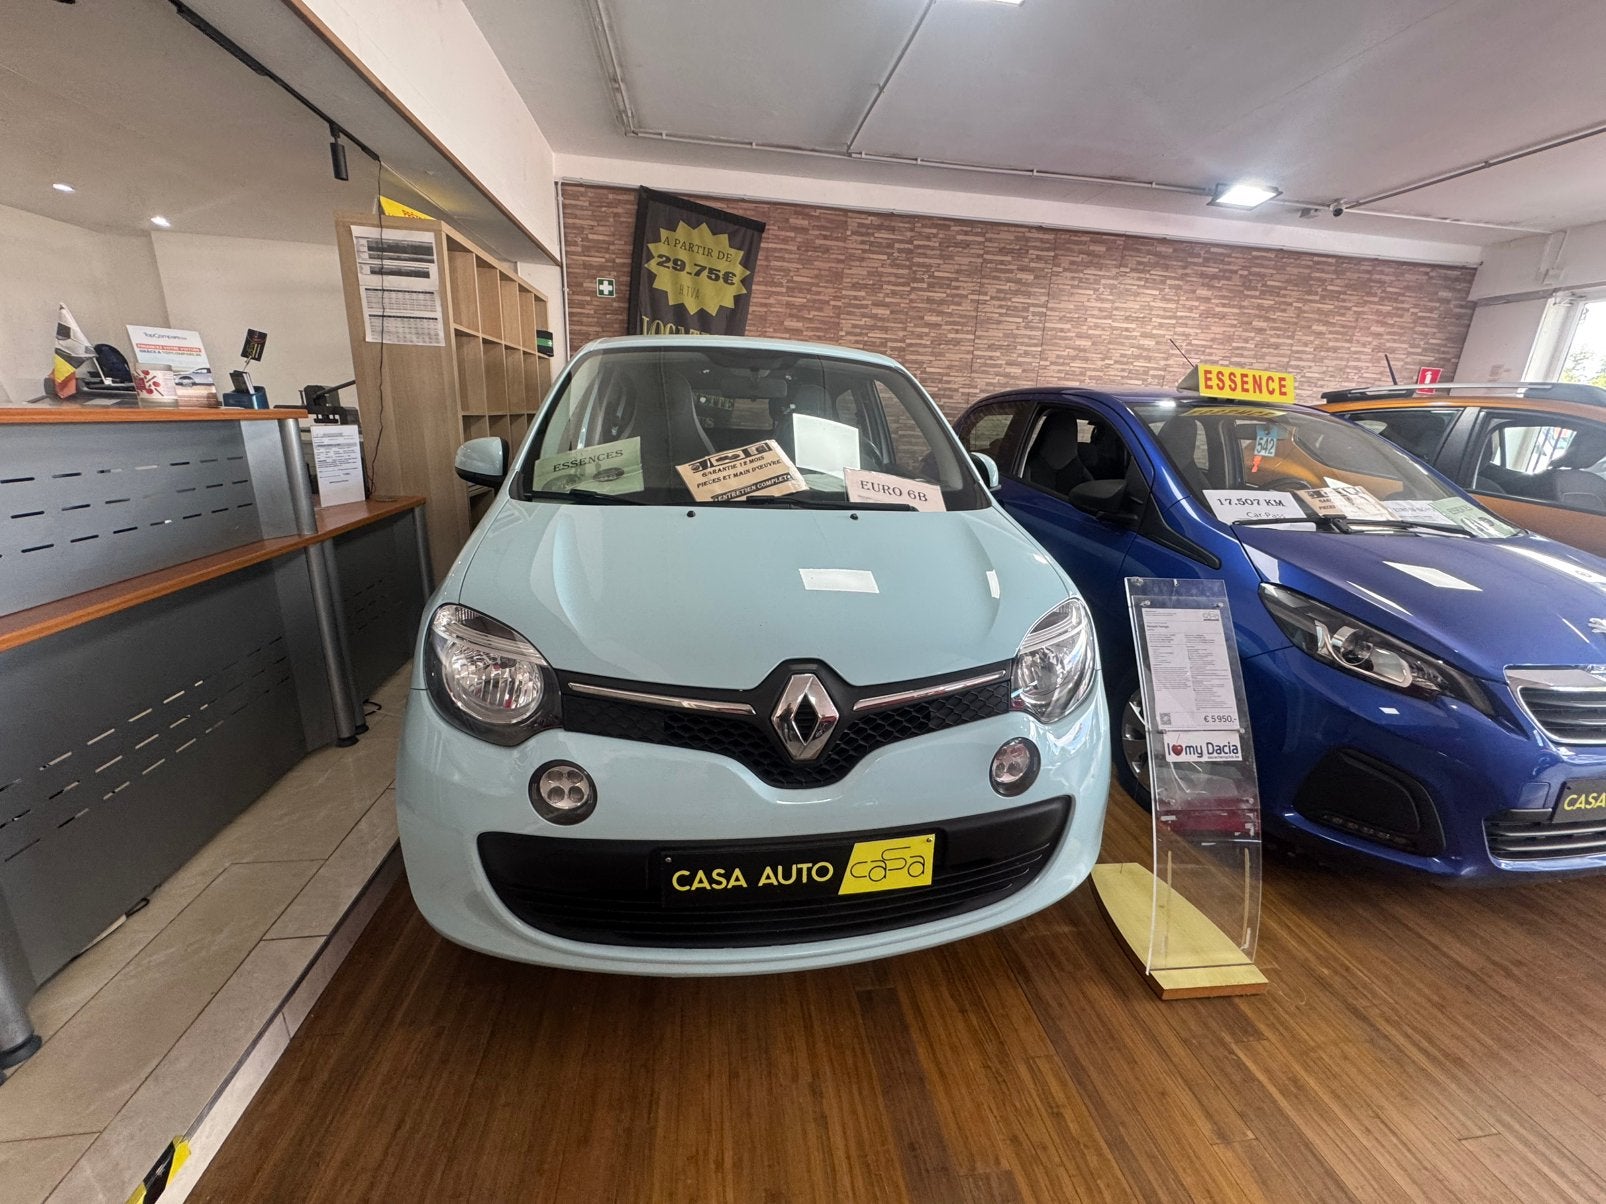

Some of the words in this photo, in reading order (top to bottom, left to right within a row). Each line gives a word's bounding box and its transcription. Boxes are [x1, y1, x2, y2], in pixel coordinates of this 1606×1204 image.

[663, 236, 671, 246] A
[674, 240, 714, 258] PARTIR
[717, 250, 733, 263] DE
[1203, 369, 1288, 396] ESSENCE
[1256, 437, 1275, 455] 542
[553, 449, 624, 472] ESSENCES
[702, 463, 738, 477] GARANTIE
[749, 455, 765, 464] MOIS
[697, 476, 722, 488] PIECES
[733, 469, 751, 479] MAIN
[860, 480, 903, 497] EURO
[907, 489, 928, 502] 6B
[1217, 498, 1261, 506] 17.507
[1264, 499, 1286, 507] KM
[1203, 715, 1210, 723] €
[1167, 742, 1171, 755] I
[1184, 745, 1203, 758] my
[1206, 741, 1239, 755] Dacia
[1563, 792, 1606, 811] CASA
[672, 868, 748, 892] CASA
[758, 861, 834, 887] AUTO
